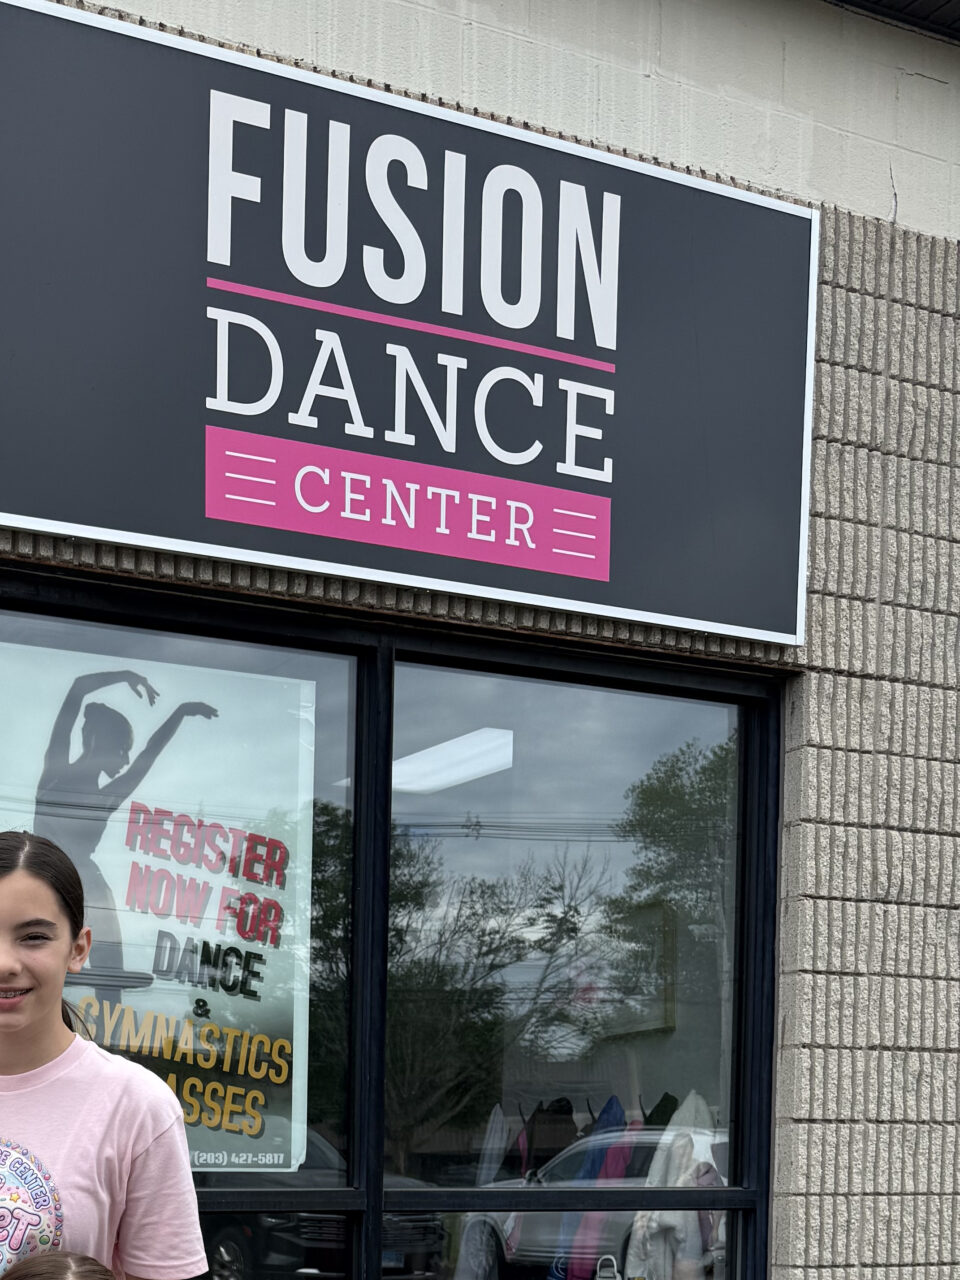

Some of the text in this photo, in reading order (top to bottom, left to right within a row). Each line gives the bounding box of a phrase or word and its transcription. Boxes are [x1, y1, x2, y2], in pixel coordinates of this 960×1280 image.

[207, 89, 621, 350] FUSION
[206, 306, 615, 483] DANCE
[294, 465, 536, 549] CENTER
[125, 801, 289, 890] REGISTER
[125, 861, 284, 948] NOW FOR
[152, 930, 266, 1000] DANCE
[193, 998, 211, 1019] &
[166, 1073, 266, 1137] SSES
[10, 1157, 51, 1210] CENTER
